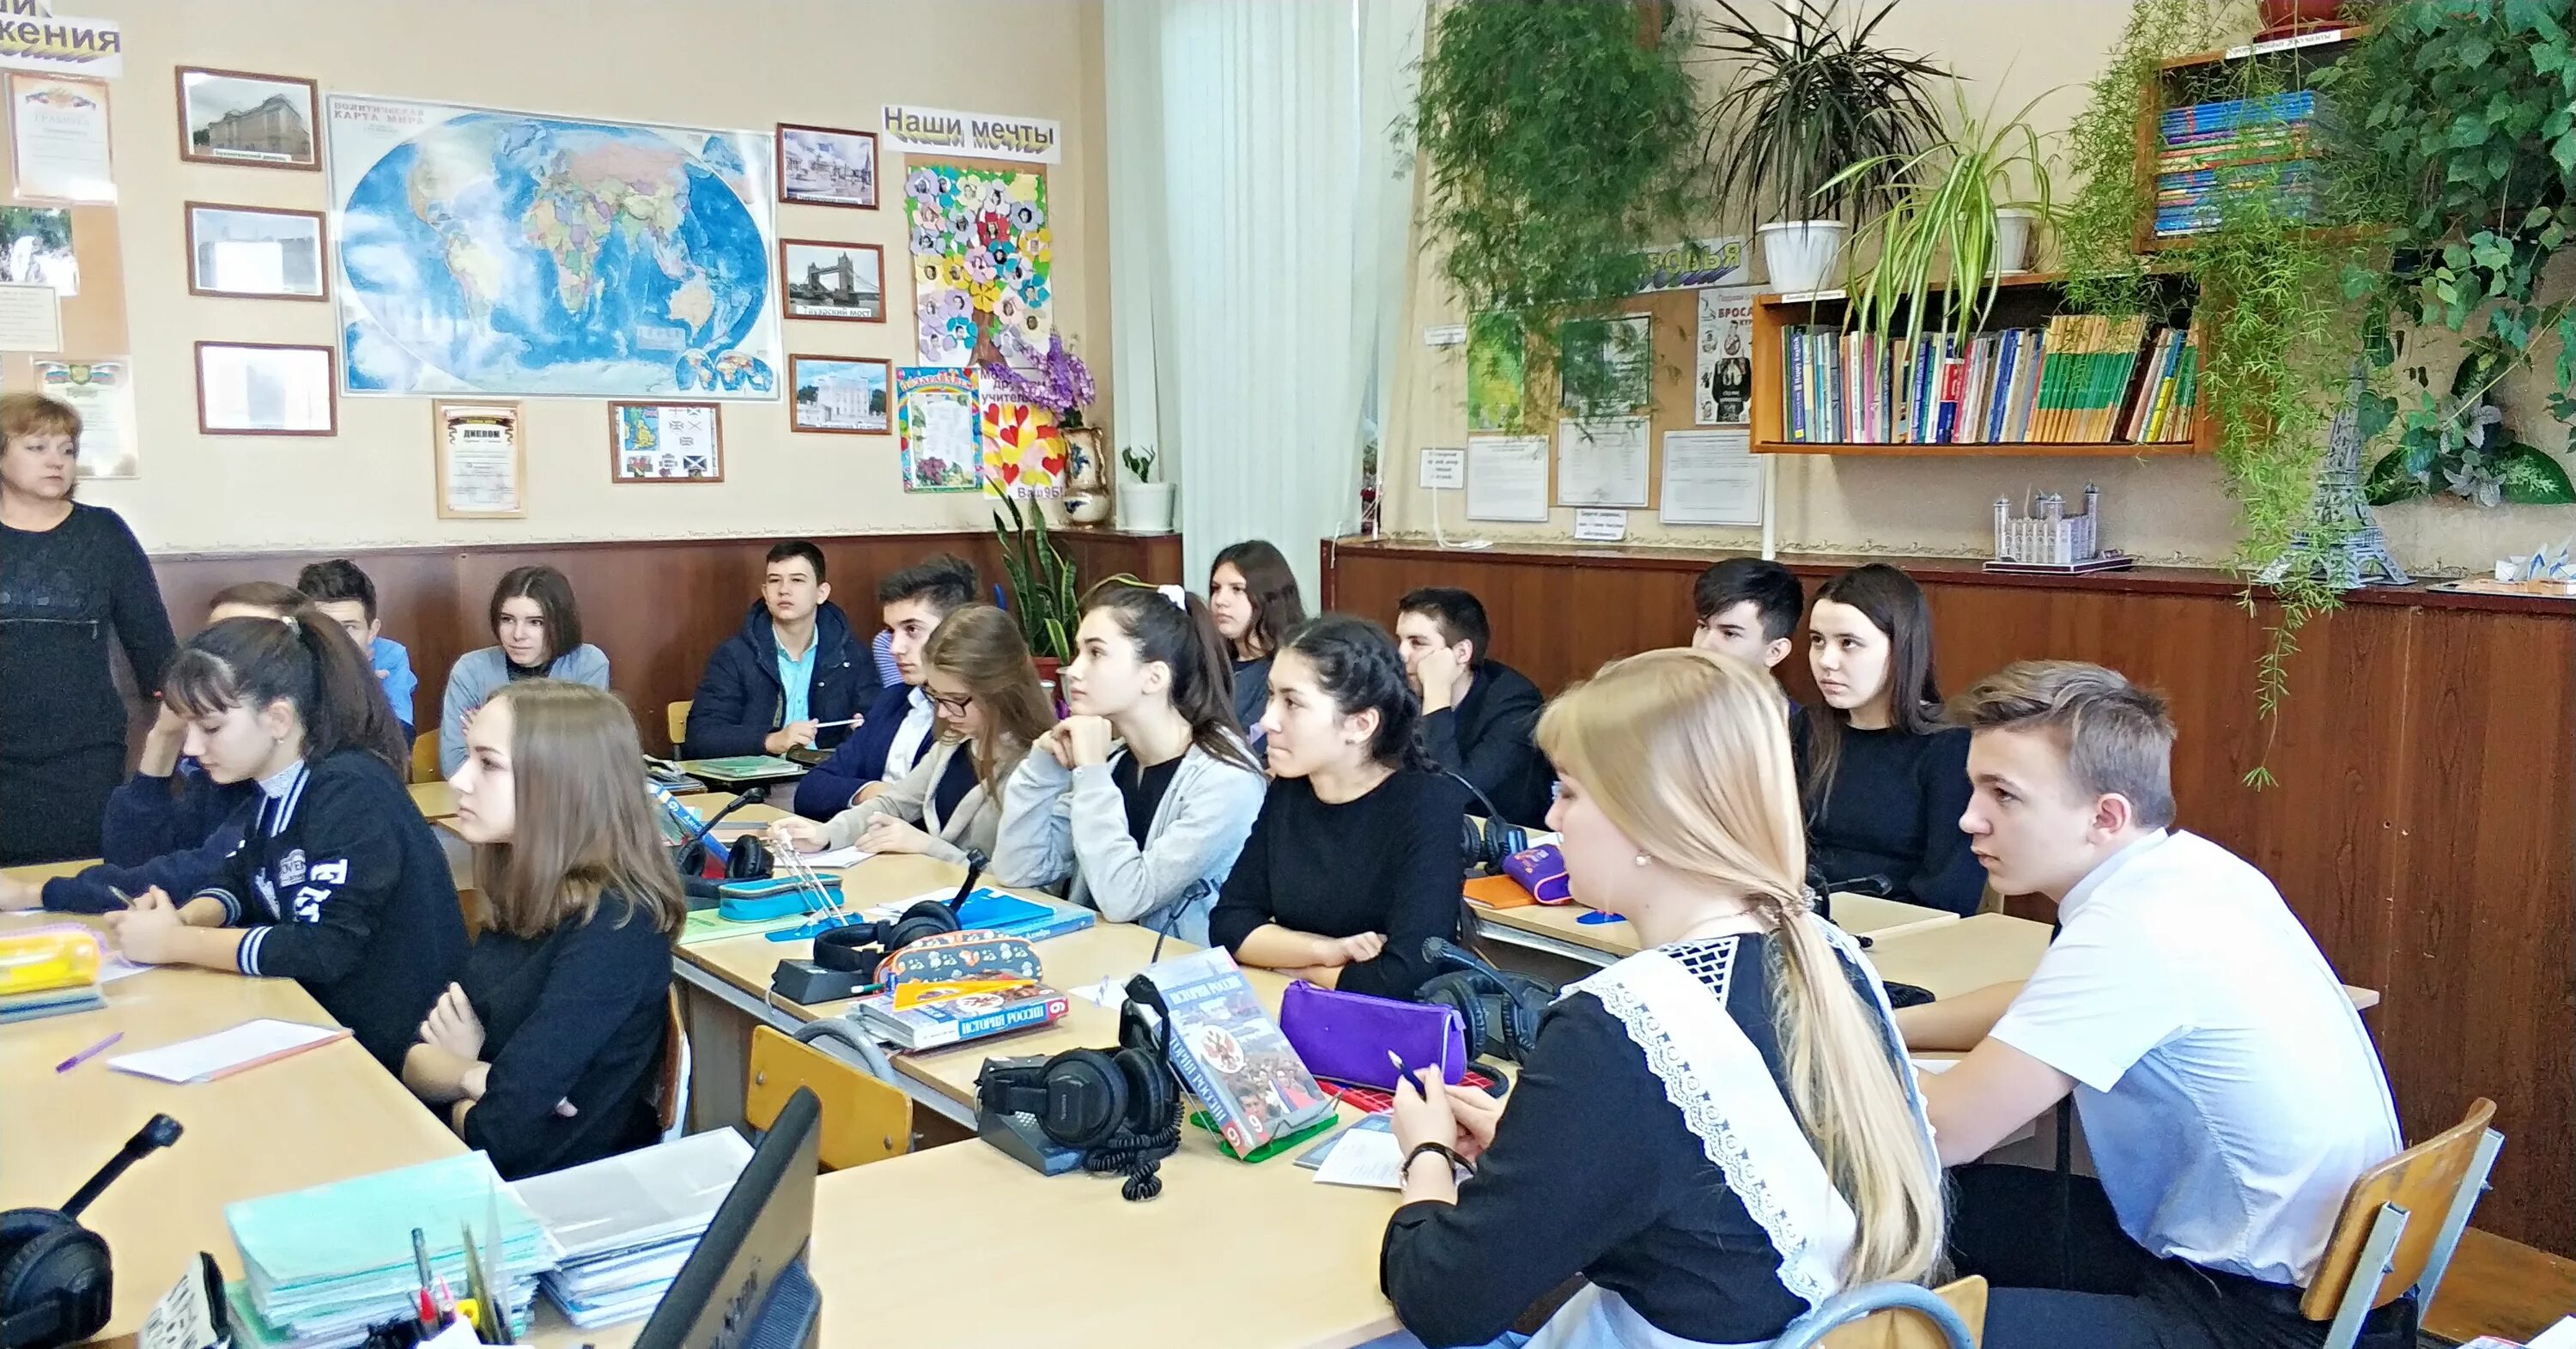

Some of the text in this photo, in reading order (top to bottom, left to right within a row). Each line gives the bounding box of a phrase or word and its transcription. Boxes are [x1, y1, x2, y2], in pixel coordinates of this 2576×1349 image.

[334, 110, 424, 125] КАРТА МИРА
[884, 107, 1054, 144] Наши мечты
[464, 429, 500, 439] ДИПЛОМ
[962, 1001, 1066, 1035] ИСТОРИЯ РОССИИ 9
[1191, 1072, 1228, 1123] РОССИИ
[1226, 1126, 1242, 1148] 9
[1248, 1114, 1263, 1134] 9
